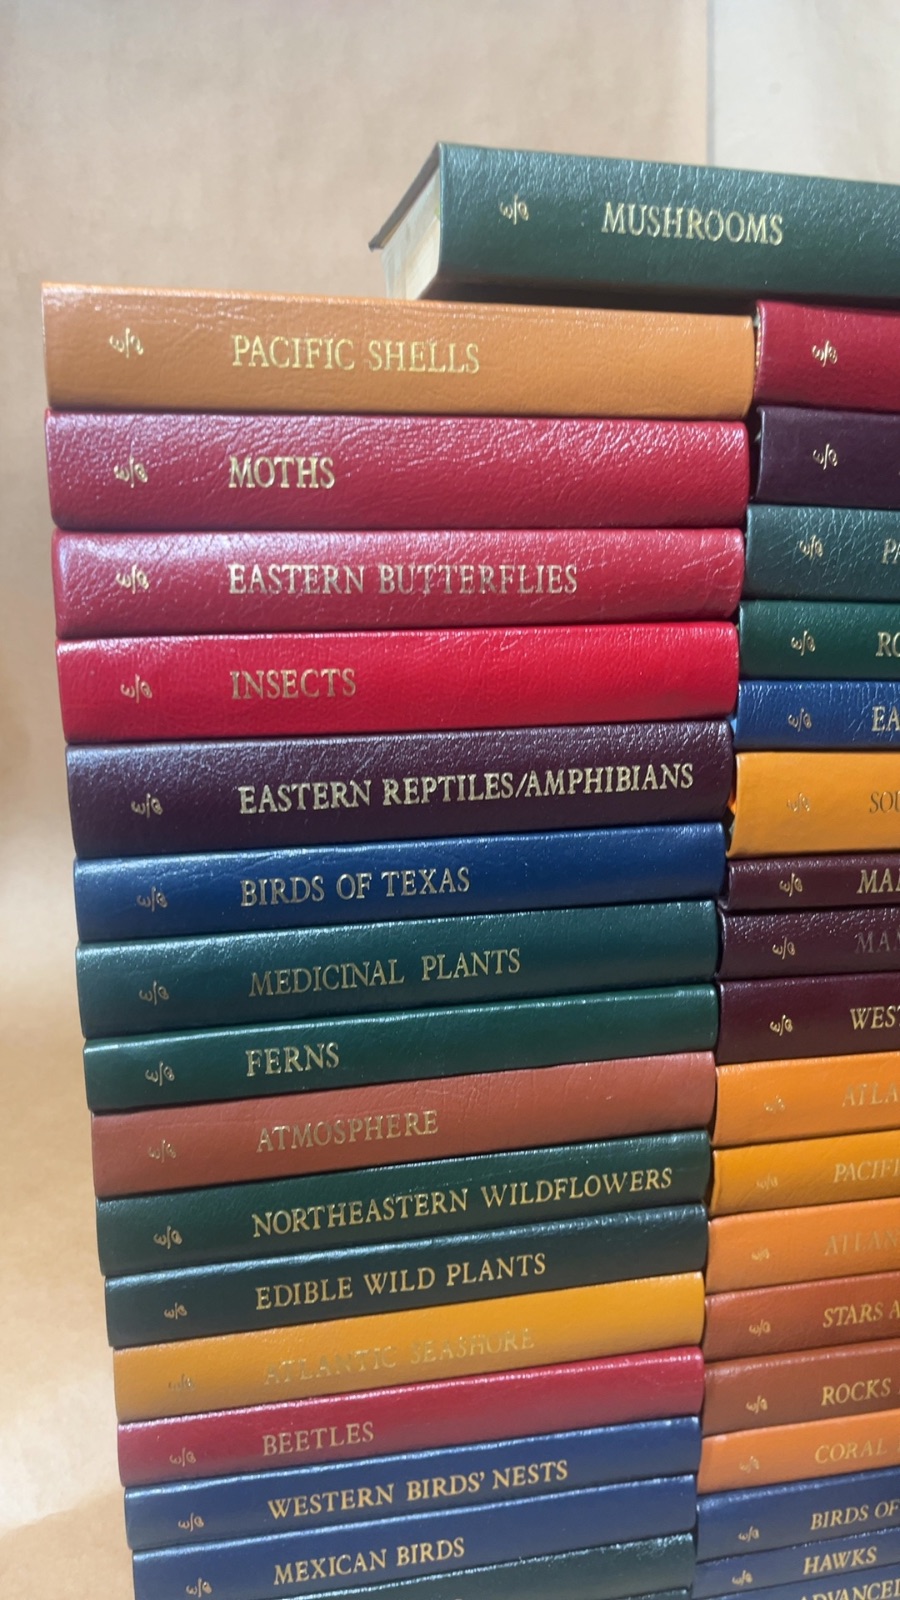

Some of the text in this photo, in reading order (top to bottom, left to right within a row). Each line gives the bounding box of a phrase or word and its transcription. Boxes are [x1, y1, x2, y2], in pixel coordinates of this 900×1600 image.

[601, 201, 783, 246] MUSHROOMS
[231, 334, 480, 375] PACIFIC SHELLS
[228, 456, 335, 489] MOTHS
[228, 564, 578, 594] EASTERN BUTTERFLIES
[230, 668, 357, 700] INSECTS
[238, 763, 694, 815] EASTERN REPTILES/AMPHIBIANS
[240, 866, 471, 907] BIRDS OF TEXAS
[248, 948, 521, 998] MEDICINAL PLANTS
[245, 1041, 340, 1077] FERNS
[255, 1110, 439, 1152] ATMOSPHERE
[252, 1167, 672, 1238] NORTHEASTERN WILDFLOWERS
[255, 1252, 547, 1310] EDIBLE WILD PLANTS
[823, 1301, 884, 1329] STARS
[264, 1327, 535, 1386] ATLANTIC SEASHORE
[821, 1377, 892, 1407] ROCKS
[262, 1421, 375, 1457] BEETLES
[815, 1438, 889, 1464] CORAL
[267, 1459, 569, 1520] WESTERN BIRDS' NESTS
[810, 1498, 900, 1531] BIRDS OF
[273, 1536, 465, 1586] MEXICAN BIRDS
[803, 1546, 878, 1575] HAWKS
